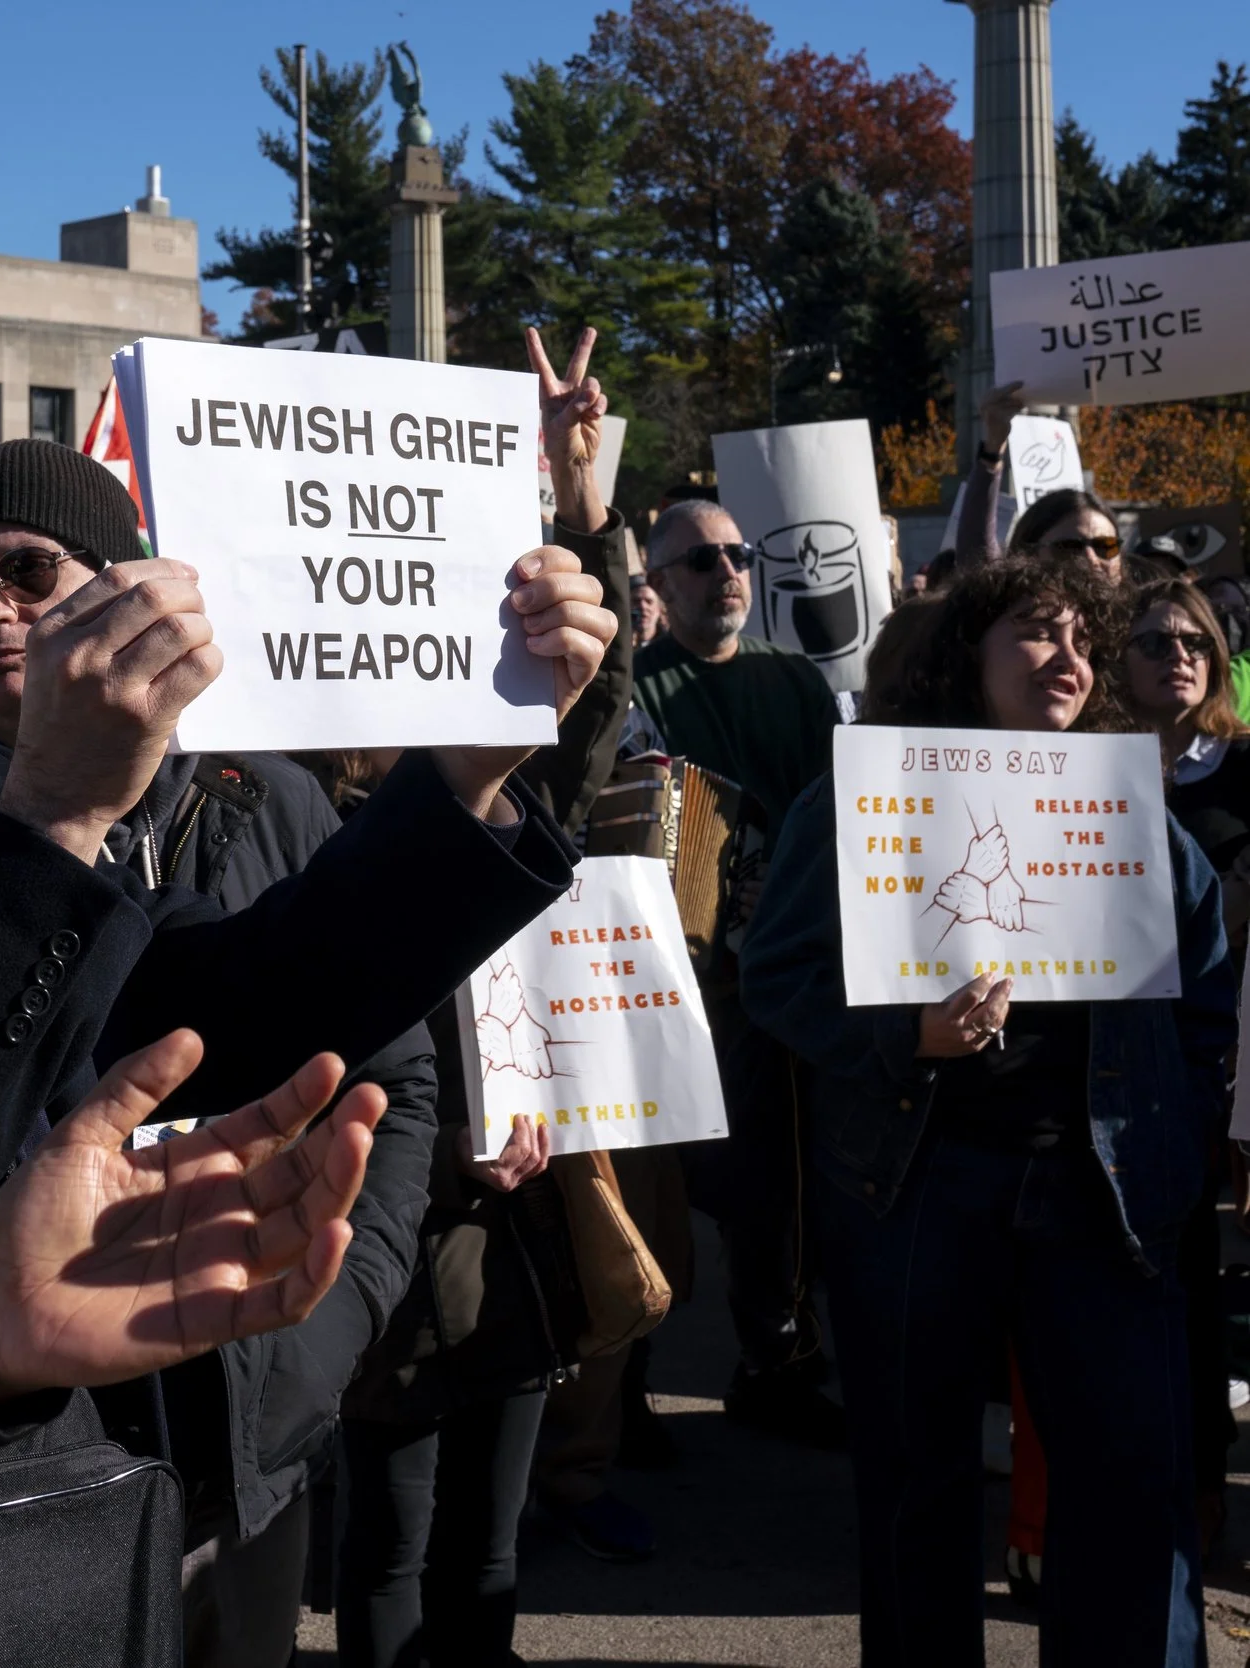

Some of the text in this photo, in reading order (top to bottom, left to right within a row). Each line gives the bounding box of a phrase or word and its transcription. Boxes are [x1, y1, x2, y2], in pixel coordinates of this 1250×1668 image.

[1069, 273, 1164, 311] عدالة
[1040, 308, 1203, 353] JUSTICE
[1083, 347, 1163, 389] צדק
[176, 397, 374, 457] JEWISH
[389, 412, 520, 468] GRIEF
[285, 480, 444, 534] IS NOT
[301, 556, 437, 608] YOUR
[262, 632, 472, 682] WEAPON
[902, 747, 1068, 775] JEWS SAY
[856, 796, 935, 815] CEASE
[1035, 799, 1129, 814] RELEASE
[867, 836, 923, 854] FIRE
[1063, 831, 1106, 845] THE
[1027, 862, 1146, 876] HOSTAGES
[865, 876, 924, 894] NOW
[590, 960, 636, 976] THE
[899, 960, 1117, 977] END APARTHEID
[549, 991, 681, 1015] HOSTAGES
